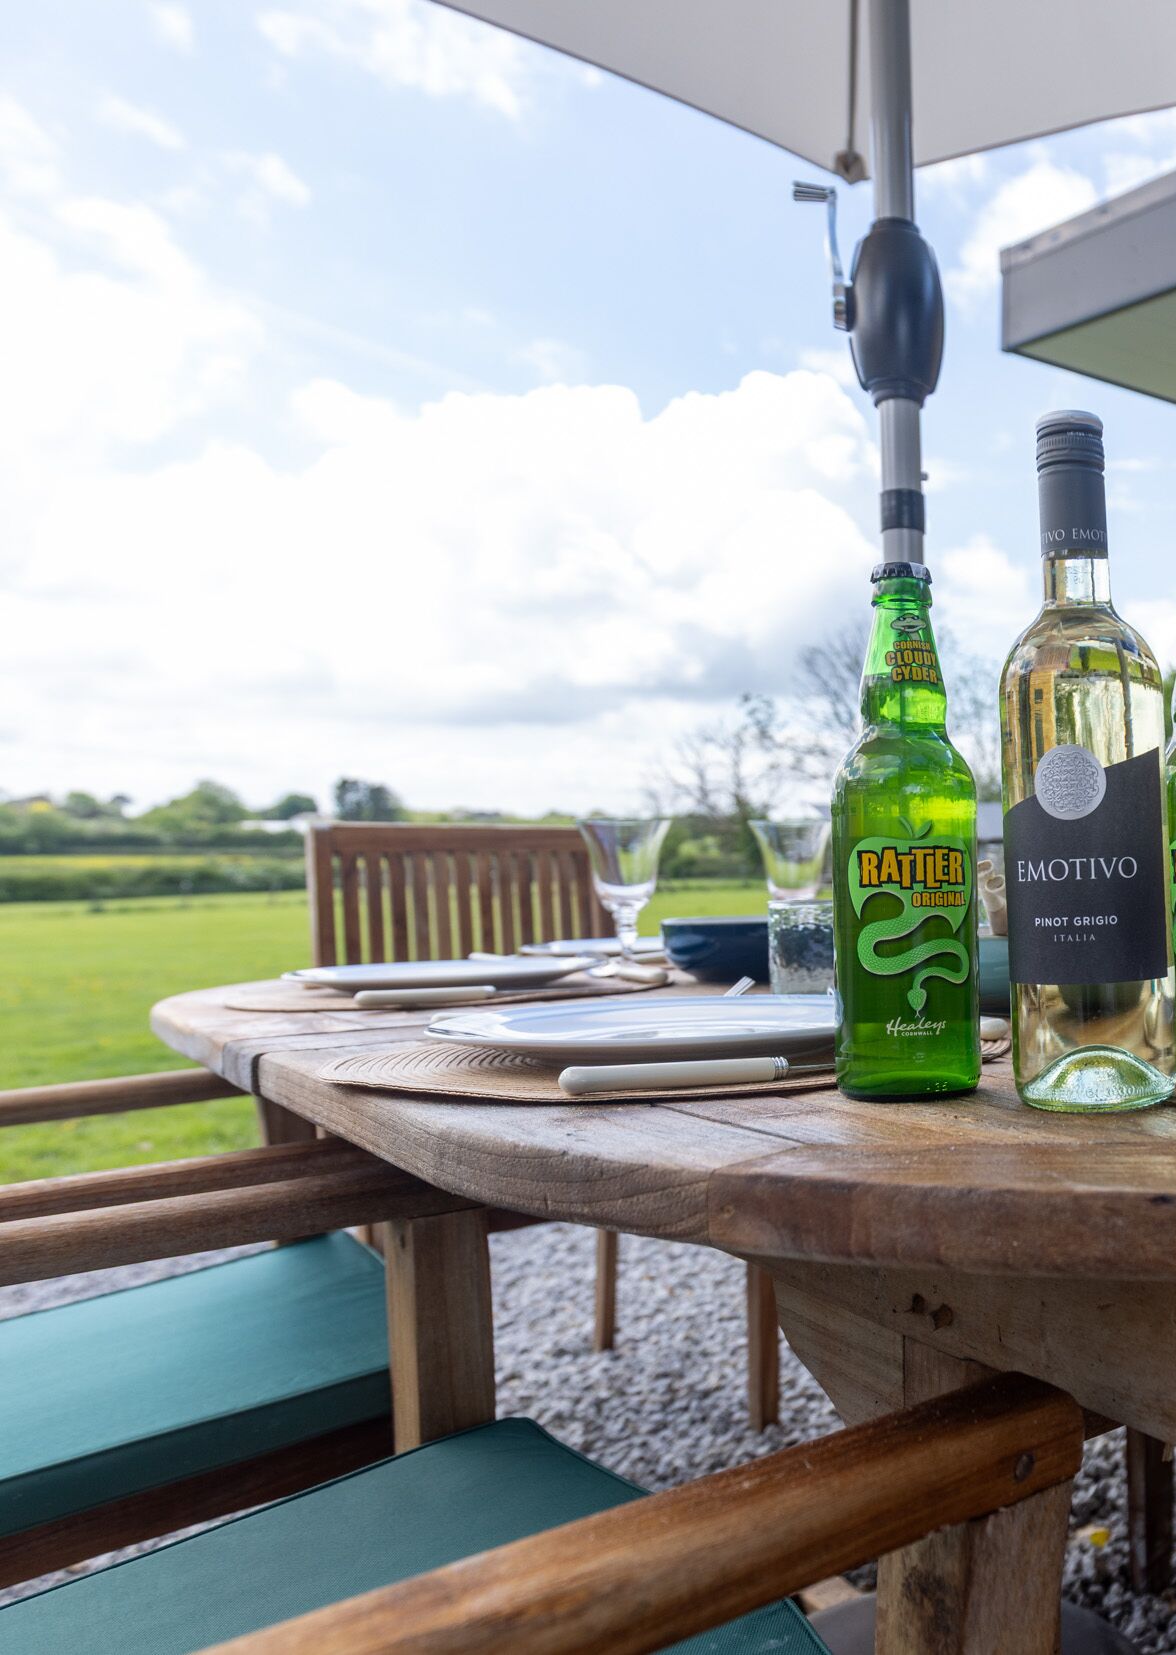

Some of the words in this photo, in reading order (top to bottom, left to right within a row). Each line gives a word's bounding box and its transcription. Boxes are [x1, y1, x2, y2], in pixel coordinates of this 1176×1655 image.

[894, 641, 931, 650] CORNISH
[885, 649, 936, 667] CLOUDY
[891, 665, 938, 684] CYDER
[857, 846, 965, 890] RATTLER
[1017, 856, 1138, 882] EMOTIVO
[911, 891, 965, 908] ORIGINAL
[1035, 917, 1068, 927] PINOT
[1073, 915, 1118, 926] GRIGIO
[1054, 933, 1096, 942] ITALIA
[886, 1016, 947, 1037] Healeys
